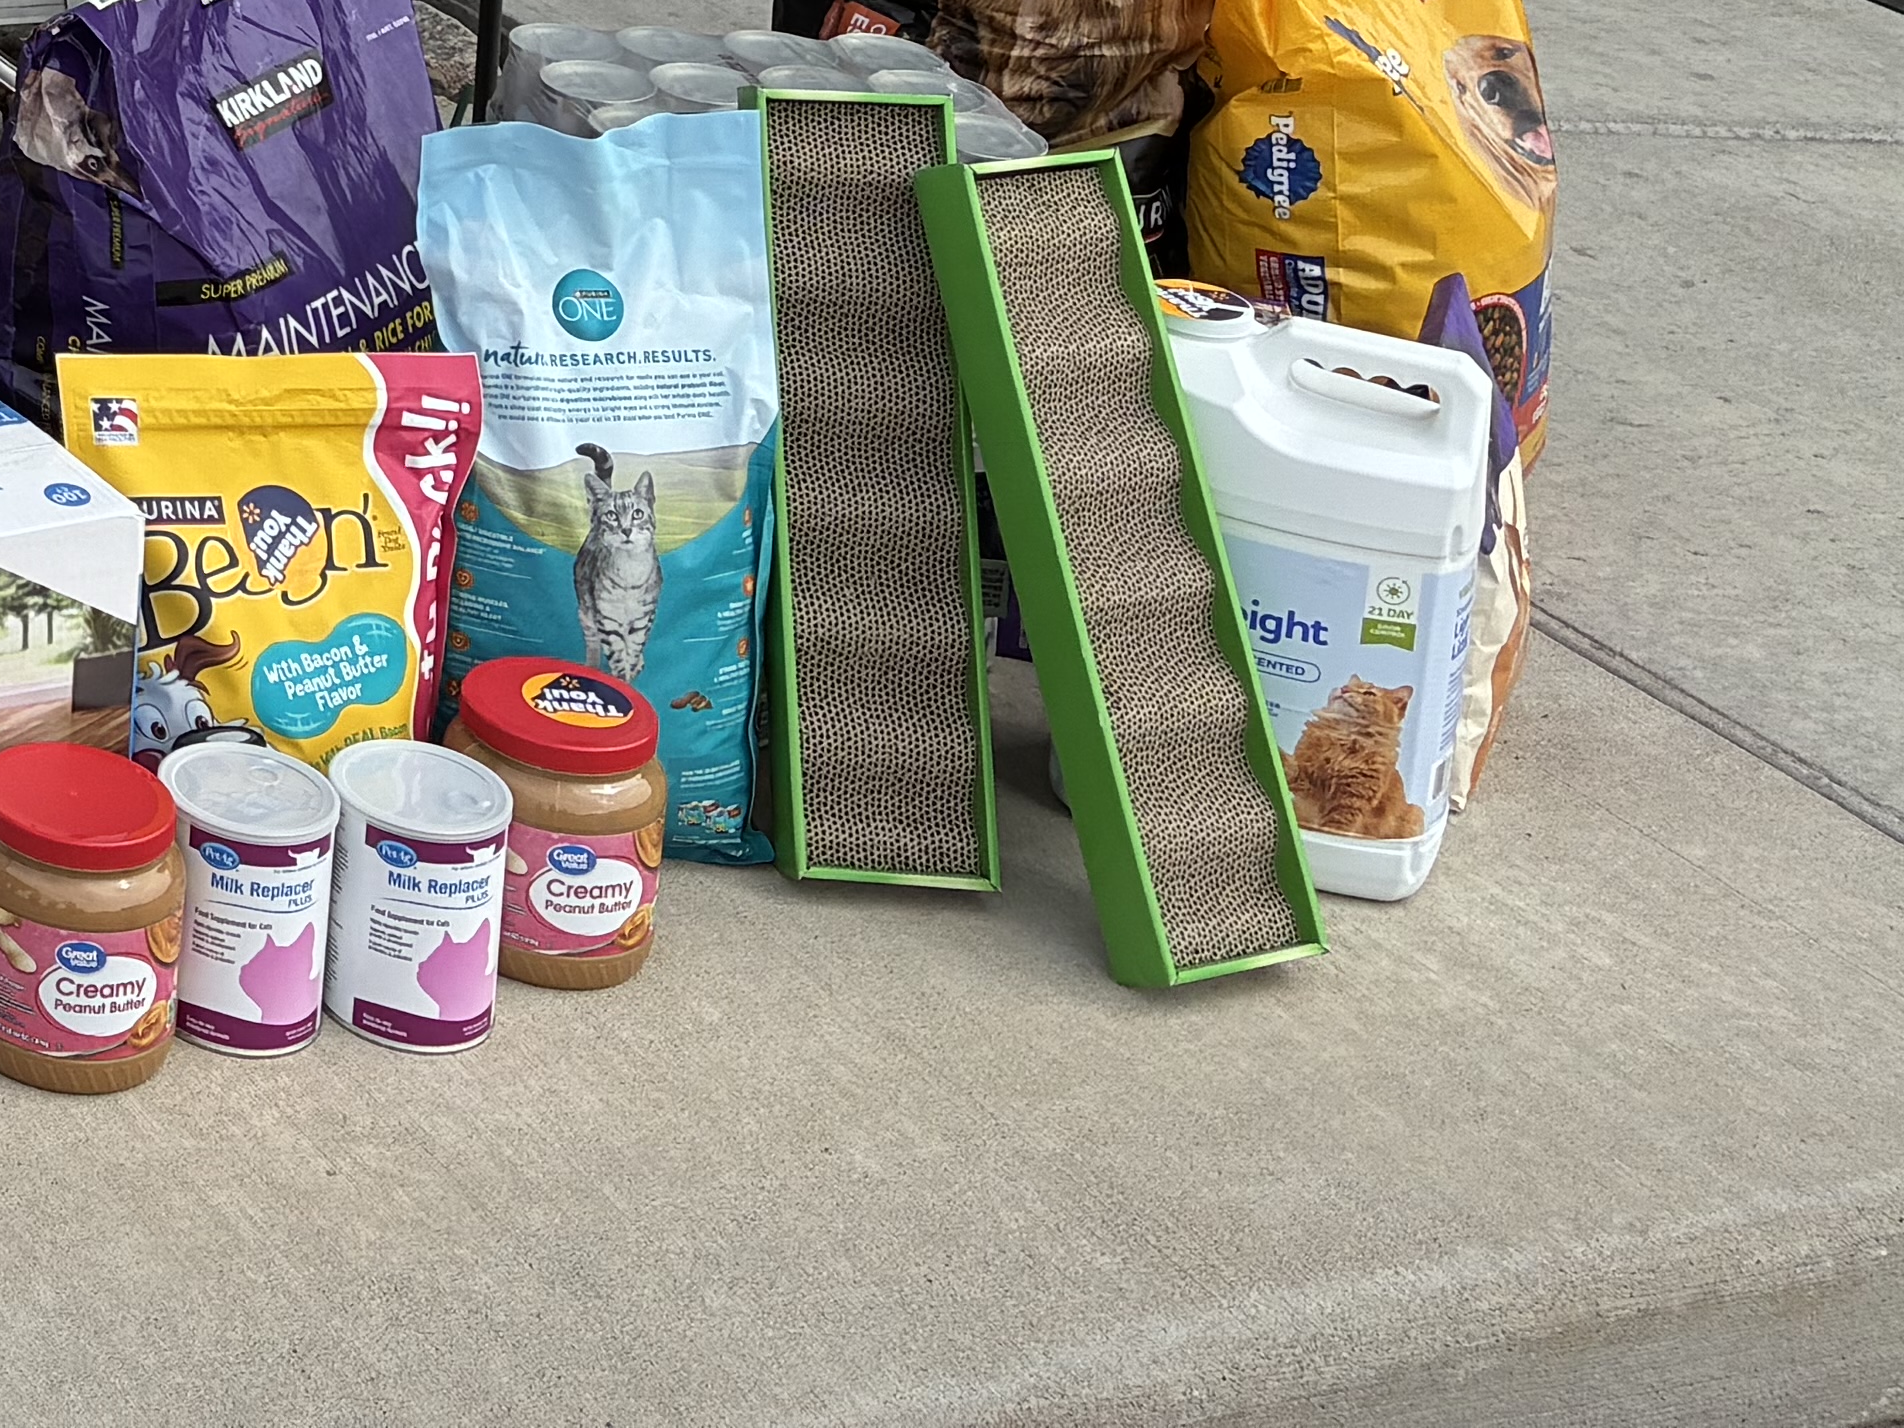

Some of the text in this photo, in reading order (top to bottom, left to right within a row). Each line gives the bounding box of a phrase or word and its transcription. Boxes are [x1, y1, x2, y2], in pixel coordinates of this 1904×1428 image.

[216, 59, 323, 127] KIRKLAND
[1271, 116, 1294, 221] Pedigree
[559, 296, 619, 322] ONE
[1369, 605, 1414, 620] 21 DAY
[264, 635, 368, 684] With Bacon &
[285, 651, 388, 700] Peanut Butter
[316, 683, 363, 712] Flavor
[552, 848, 588, 865] Great
[209, 873, 315, 899] Milk Replacer
[387, 869, 491, 896] Milk Replacer
[546, 876, 634, 902] Creamy
[286, 896, 313, 909] PLUS
[463, 892, 490, 906] PLUS
[545, 896, 634, 915] Peanut Butter
[61, 947, 98, 963] Great
[55, 975, 147, 1003] Creamy
[53, 993, 147, 1015] Peanut Butter
